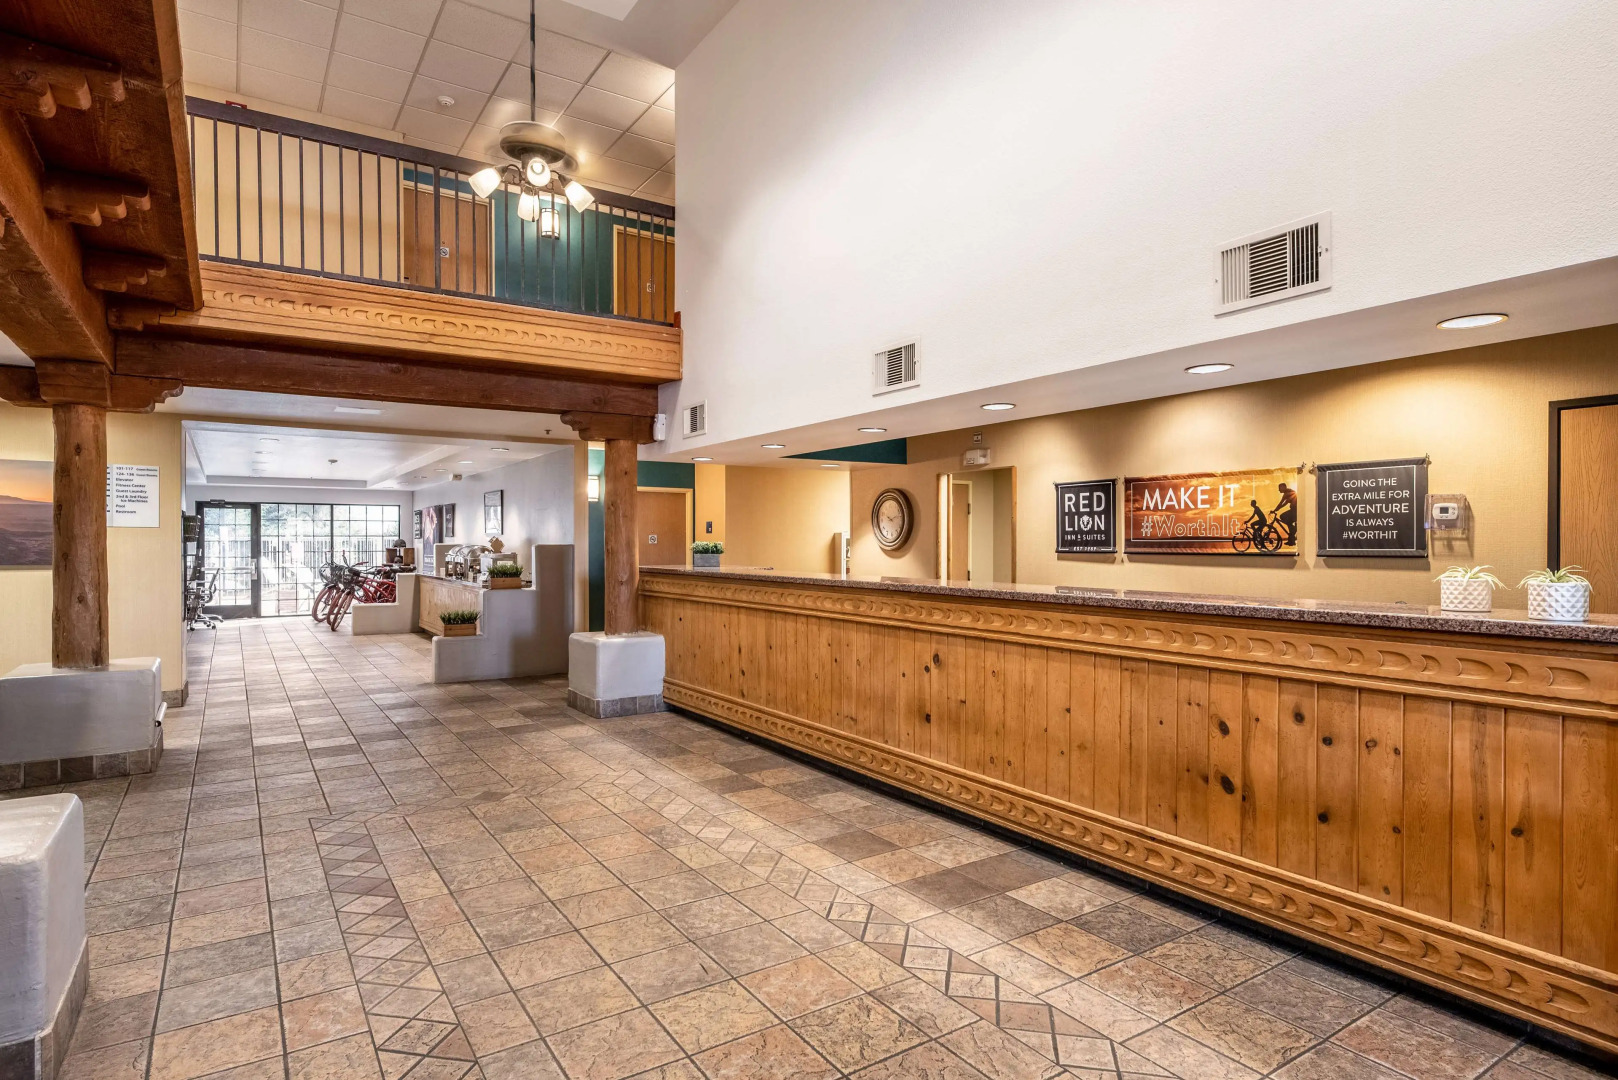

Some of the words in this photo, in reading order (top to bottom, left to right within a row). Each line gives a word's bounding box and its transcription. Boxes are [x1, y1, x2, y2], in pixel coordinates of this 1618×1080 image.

[1342, 479, 1376, 488] GOING
[1378, 478, 1397, 486] THE
[1142, 486, 1210, 510] MAKE
[1219, 484, 1239, 508] IT
[1332, 493, 1361, 501] EXTRA
[1363, 491, 1386, 500] MILE
[1388, 490, 1410, 498] FOR
[1064, 492, 1105, 512] RED
[1332, 503, 1409, 515] ADVENTURE
[1065, 514, 1104, 531] LION
[1141, 514, 1240, 537] #WorthIt
[1356, 518, 1394, 526] ALWAYS
[1342, 530, 1398, 540] #WORTHIT
